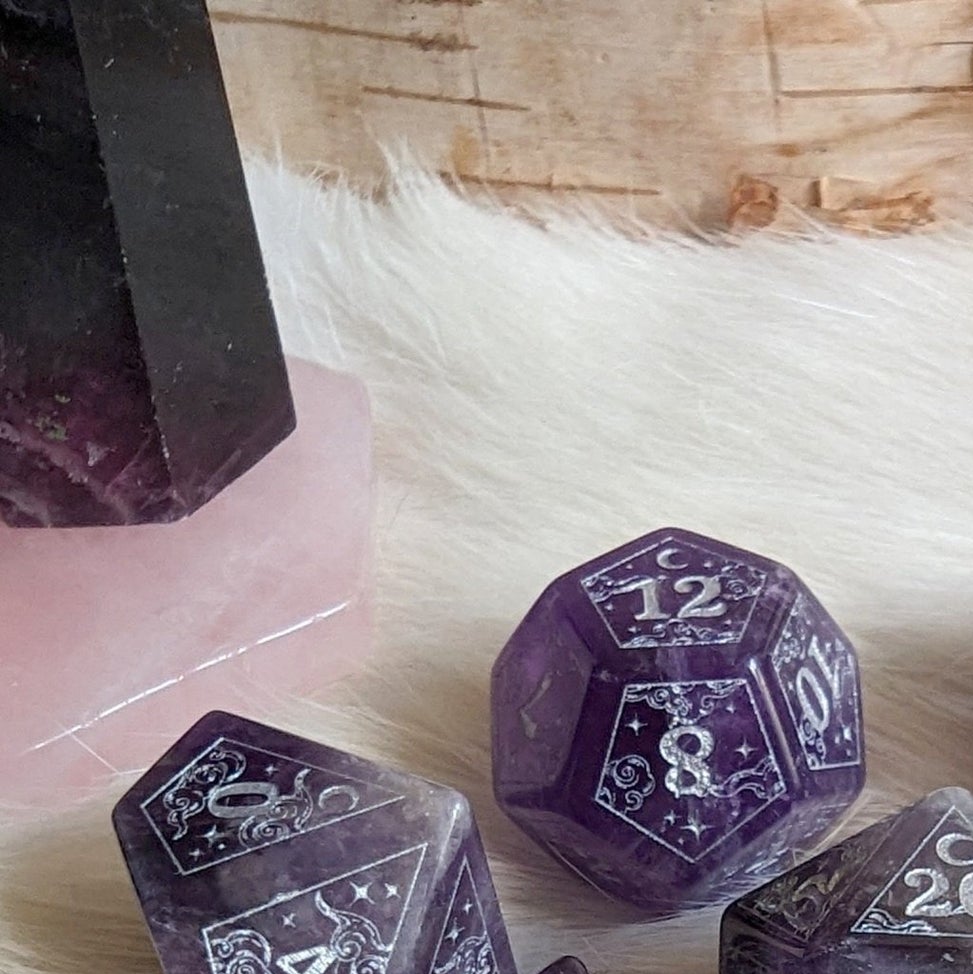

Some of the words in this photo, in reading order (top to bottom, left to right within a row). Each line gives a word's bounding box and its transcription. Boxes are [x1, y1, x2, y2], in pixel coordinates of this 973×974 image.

[631, 575, 728, 621] 12
[659, 724, 714, 797] 8
[207, 781, 280, 819] 0
